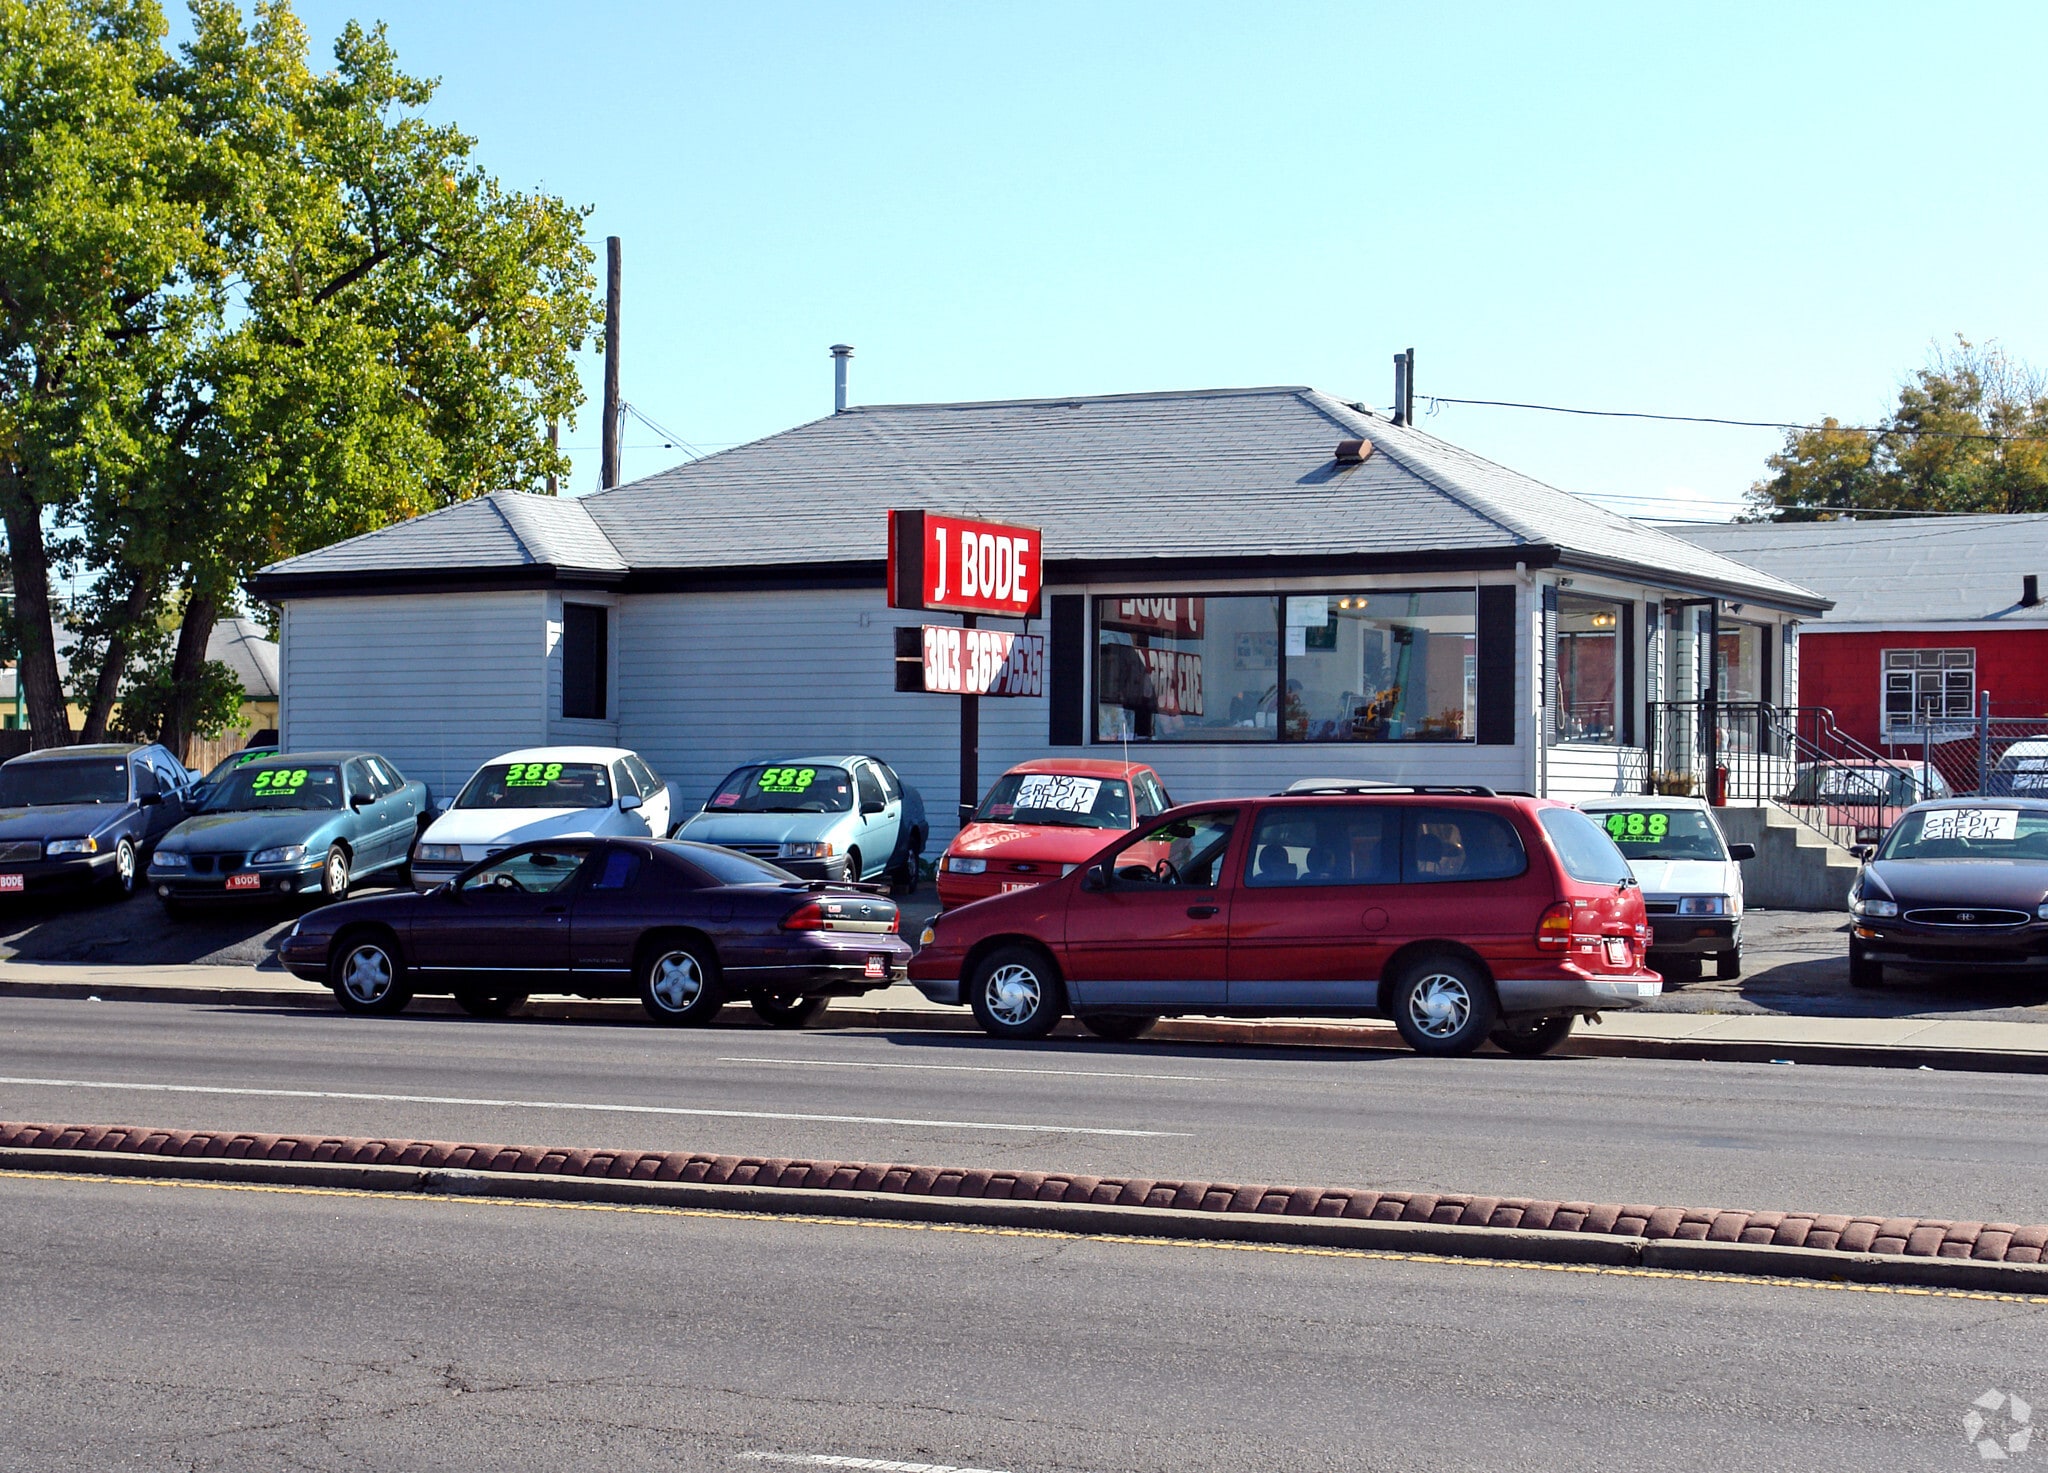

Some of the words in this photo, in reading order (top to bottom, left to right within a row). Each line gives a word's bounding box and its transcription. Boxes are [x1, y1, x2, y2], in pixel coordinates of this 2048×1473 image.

[961, 530, 1029, 603] BODE
[924, 627, 961, 690] 303
[252, 769, 307, 789] 588
[505, 763, 563, 781] 388
[758, 768, 816, 787] 588
[1050, 776, 1075, 786] NO
[1019, 784, 1095, 798] CREDIT
[1017, 794, 1089, 812] CHECK
[1957, 810, 1982, 818] NO
[1607, 813, 1668, 836] 488
[1926, 817, 2007, 829] CREDIT
[1924, 826, 2000, 839] CHECK
[0, 875, 23, 888] BODE
[235, 876, 259, 885] BODE
